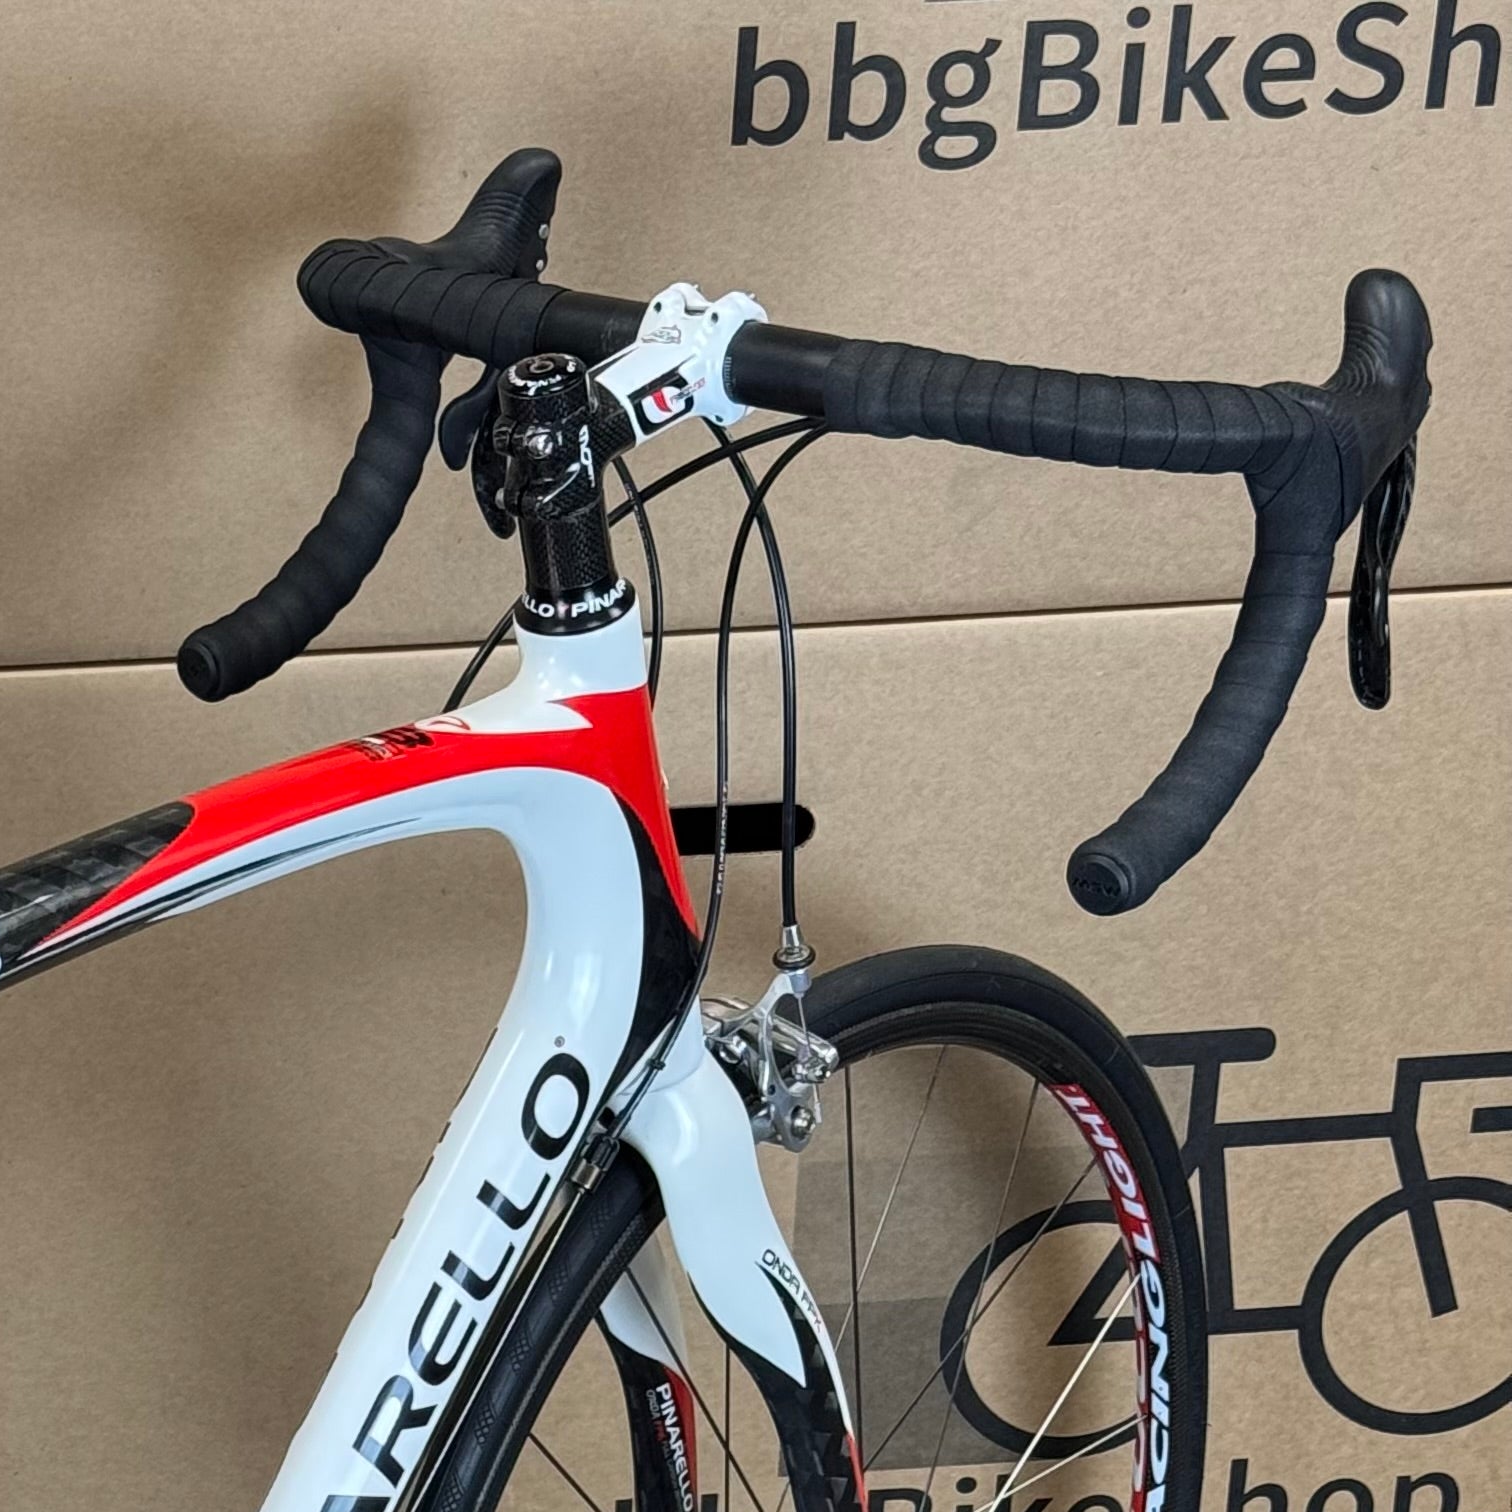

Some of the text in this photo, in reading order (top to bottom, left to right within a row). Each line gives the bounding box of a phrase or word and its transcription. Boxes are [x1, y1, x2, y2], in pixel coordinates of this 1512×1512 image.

[729, 0, 1501, 171] bbgBikeSh
[1055, 1089, 1160, 1263] LIGHT
[655, 1382, 694, 1512] PINARELLO
